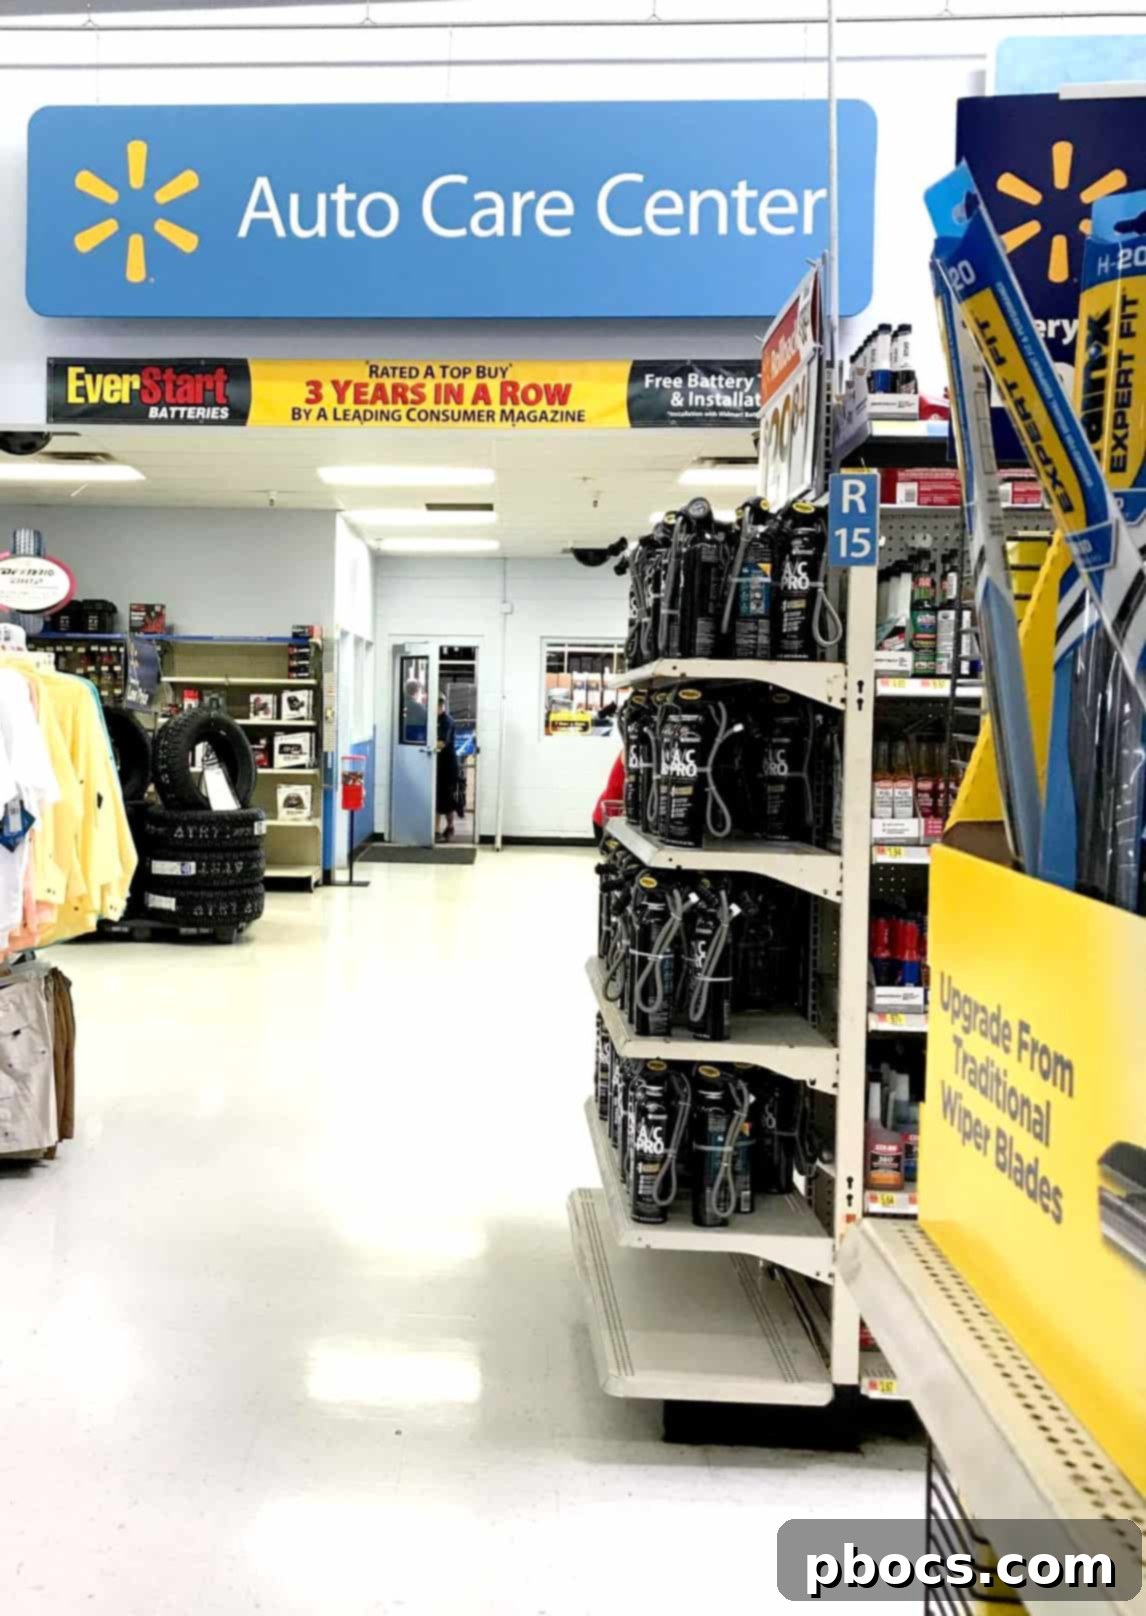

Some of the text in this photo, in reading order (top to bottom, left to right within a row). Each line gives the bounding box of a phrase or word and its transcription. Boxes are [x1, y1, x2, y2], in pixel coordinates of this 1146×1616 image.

[237, 171, 827, 239] Auto Care Center
[1035, 317, 1079, 346] ery
[1119, 294, 1139, 339] FIT
[66, 365, 229, 405] EverStart
[368, 364, 509, 379] RATED A TOP BUY
[644, 372, 755, 392] Free Battery
[304, 380, 572, 406] 3 YEARS IN A ROW
[670, 391, 762, 407] & Installat
[148, 405, 230, 420] BATTERIES
[291, 407, 586, 422] BY A LEADING CONSUMER MAGAZINE
[1110, 348, 1136, 473] EXPERT
[841, 478, 867, 514] R
[834, 527, 872, 558] 15
[940, 971, 1075, 1099] Upgrade From
[952, 1034, 1052, 1148] Traditional
[940, 1080, 1064, 1225] Wiper Blades
